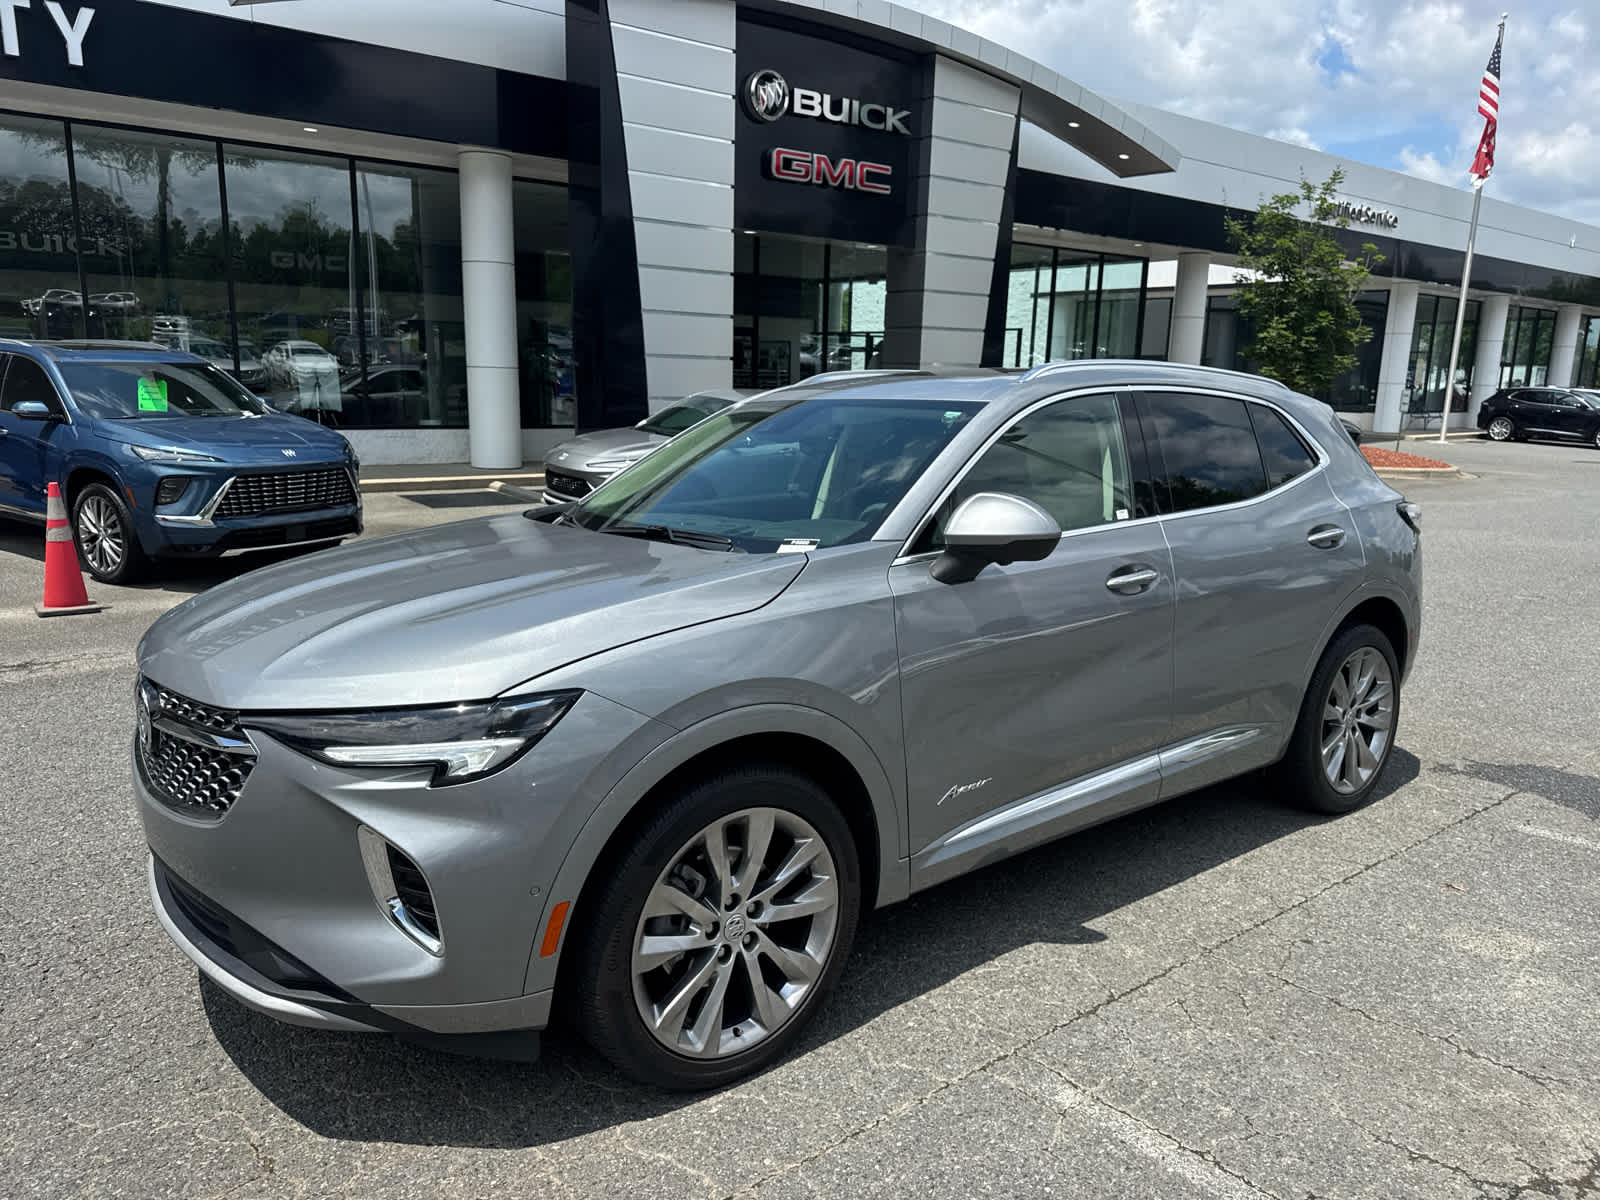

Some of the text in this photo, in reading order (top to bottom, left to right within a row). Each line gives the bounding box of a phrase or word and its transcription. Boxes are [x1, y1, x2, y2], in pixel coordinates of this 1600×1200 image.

[0, 0, 95, 67] TY
[793, 87, 912, 136] BUICK
[771, 147, 893, 195] GMC
[1362, 205, 1398, 229] Service
[271, 251, 346, 271] GMC
